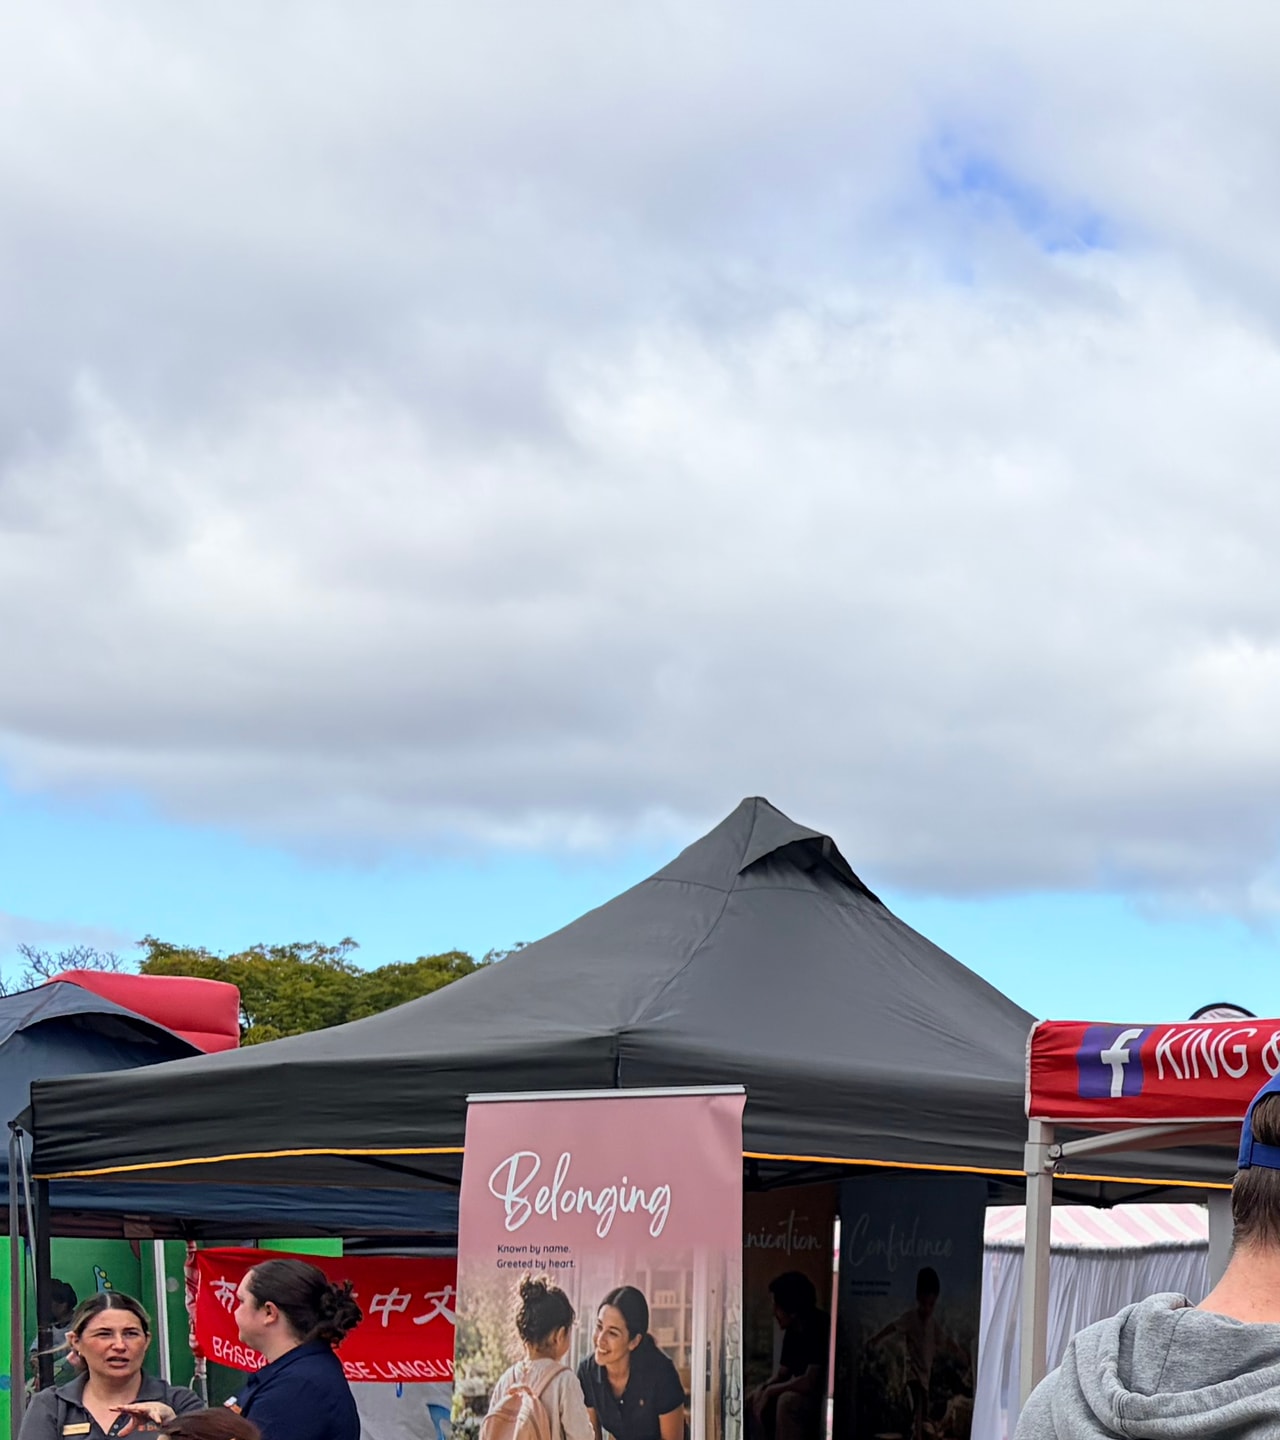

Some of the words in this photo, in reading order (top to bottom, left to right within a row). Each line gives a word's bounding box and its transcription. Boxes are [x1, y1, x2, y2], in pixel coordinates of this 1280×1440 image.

[1155, 1027, 1258, 1080] KING
[488, 1151, 671, 1238] Belonging
[496, 1259, 533, 1269] Greeted
[535, 1259, 546, 1270] by
[548, 1259, 576, 1269] heart.
[497, 1244, 528, 1253] Known
[530, 1244, 541, 1255] by
[542, 1245, 572, 1254] name.
[849, 1213, 953, 1272] Confidence
[368, 1286, 457, 1328] 中文
